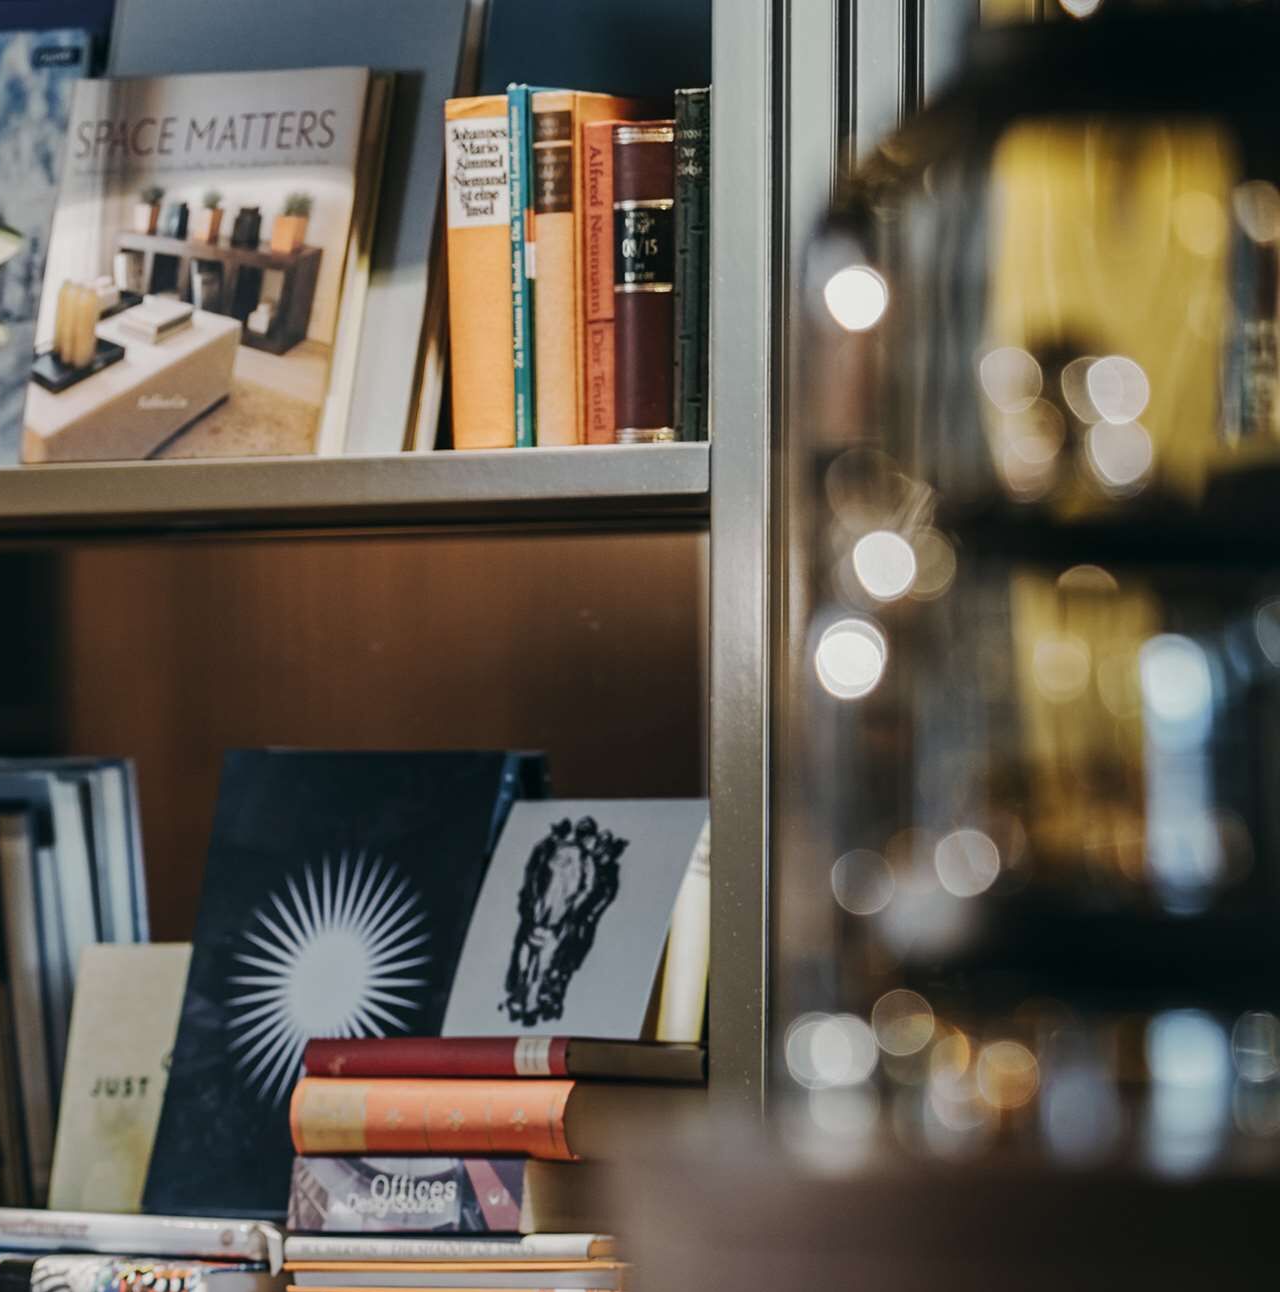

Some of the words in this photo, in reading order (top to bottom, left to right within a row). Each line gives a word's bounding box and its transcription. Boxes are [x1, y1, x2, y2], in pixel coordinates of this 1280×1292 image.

[74, 117, 178, 159] SPACE
[184, 108, 336, 152] MATTERS
[452, 128, 507, 142] Johannes
[459, 142, 499, 155] Mario
[456, 155, 503, 171] Simmel
[454, 173, 507, 189] Niemand
[589, 146, 604, 206] Alfred
[463, 201, 495, 217] Insel
[591, 216, 603, 313] Neumann
[592, 330, 604, 362] Der
[593, 372, 607, 431] Teufel
[90, 1077, 148, 1098] JUST
[370, 1174, 457, 1200] Offices
